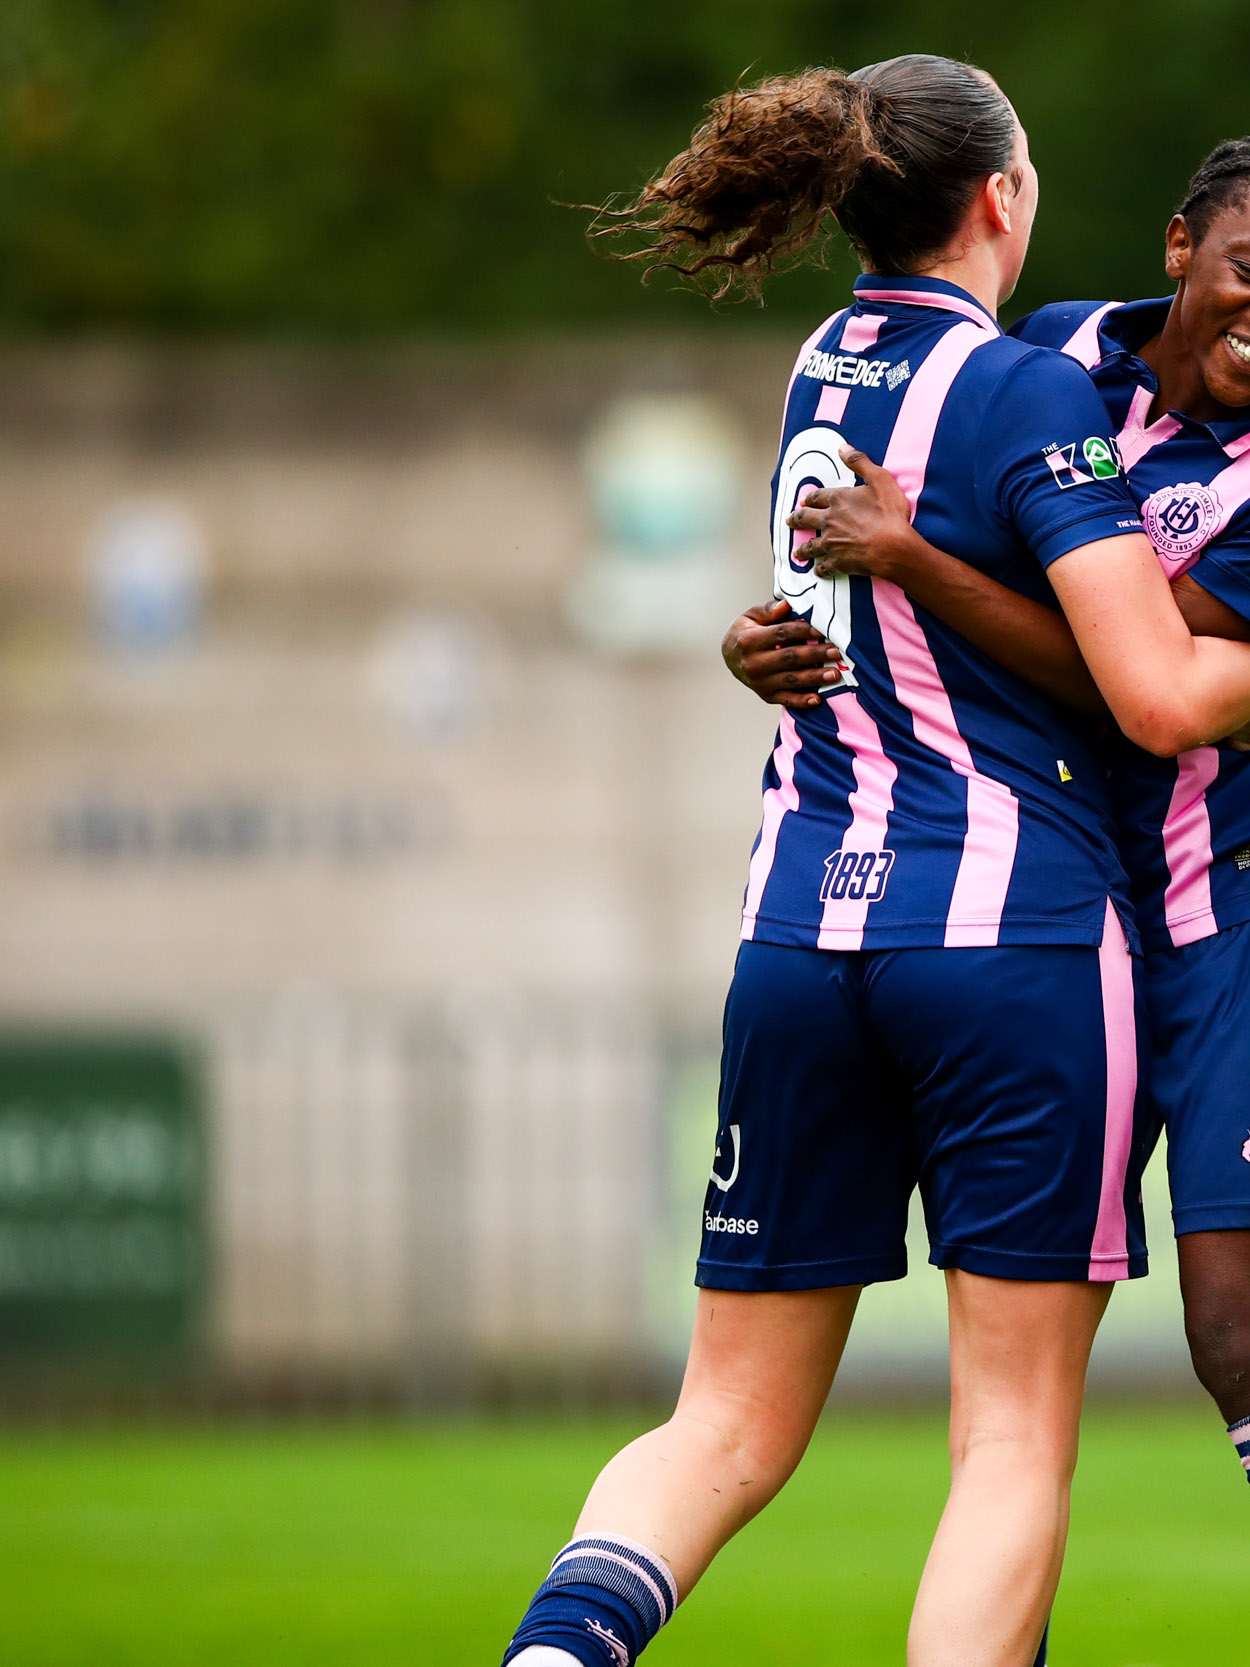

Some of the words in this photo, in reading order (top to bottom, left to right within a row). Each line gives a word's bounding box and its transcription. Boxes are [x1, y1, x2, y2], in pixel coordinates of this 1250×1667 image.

[1041, 442, 1060, 456] THE
[1156, 489, 1195, 503] DULWICH
[1196, 491, 1213, 519] HAMLET
[1149, 515, 1173, 550] FOUNDED
[1175, 542, 1193, 551] 1893
[819, 849, 896, 902] 1893
